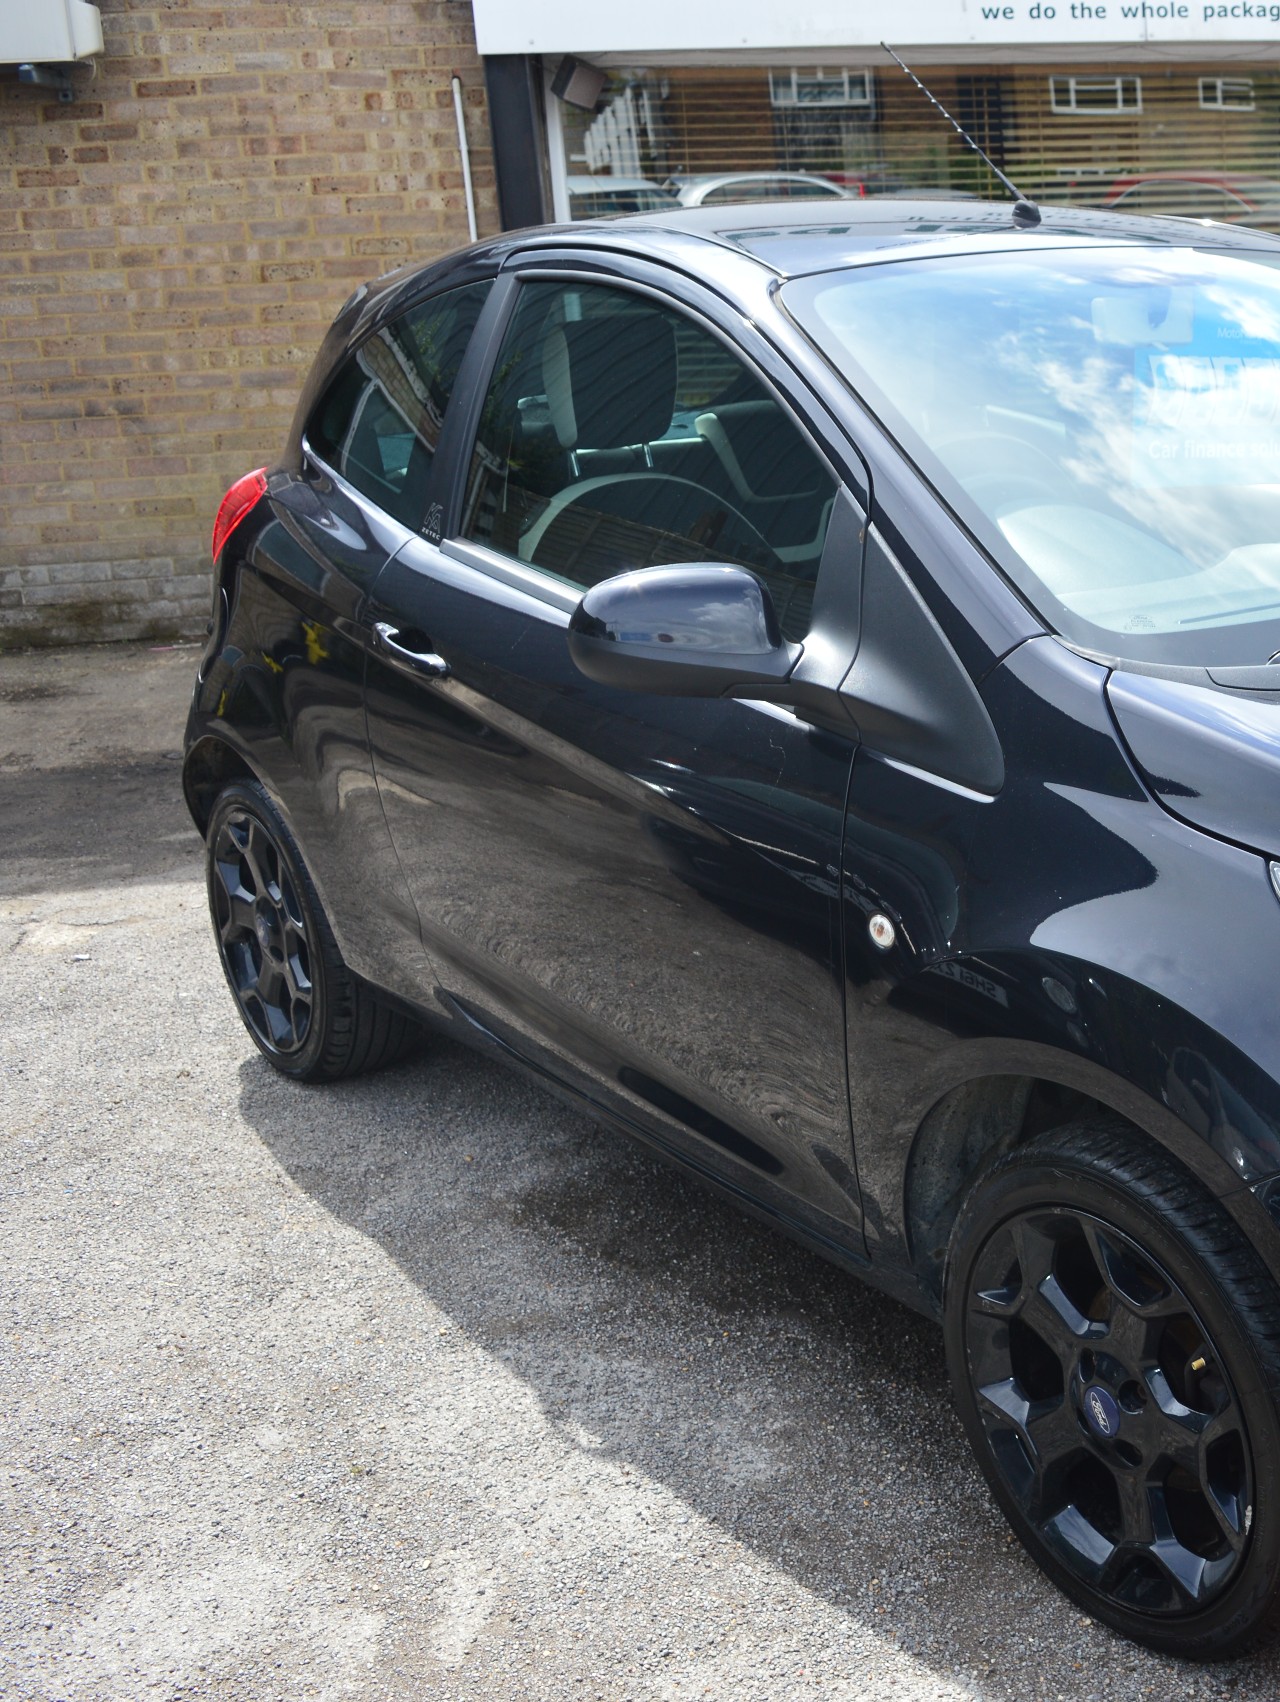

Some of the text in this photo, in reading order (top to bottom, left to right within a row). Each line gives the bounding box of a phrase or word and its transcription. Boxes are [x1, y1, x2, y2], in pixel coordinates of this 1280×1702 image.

[981, 6, 1014, 20] we
[1029, 2, 1056, 19] do
[1070, 2, 1107, 19] the
[1121, 1, 1189, 18] whole
[1148, 439, 1178, 459] Car
[1184, 439, 1246, 459] finance
[421, 526, 441, 540] ZETEC
